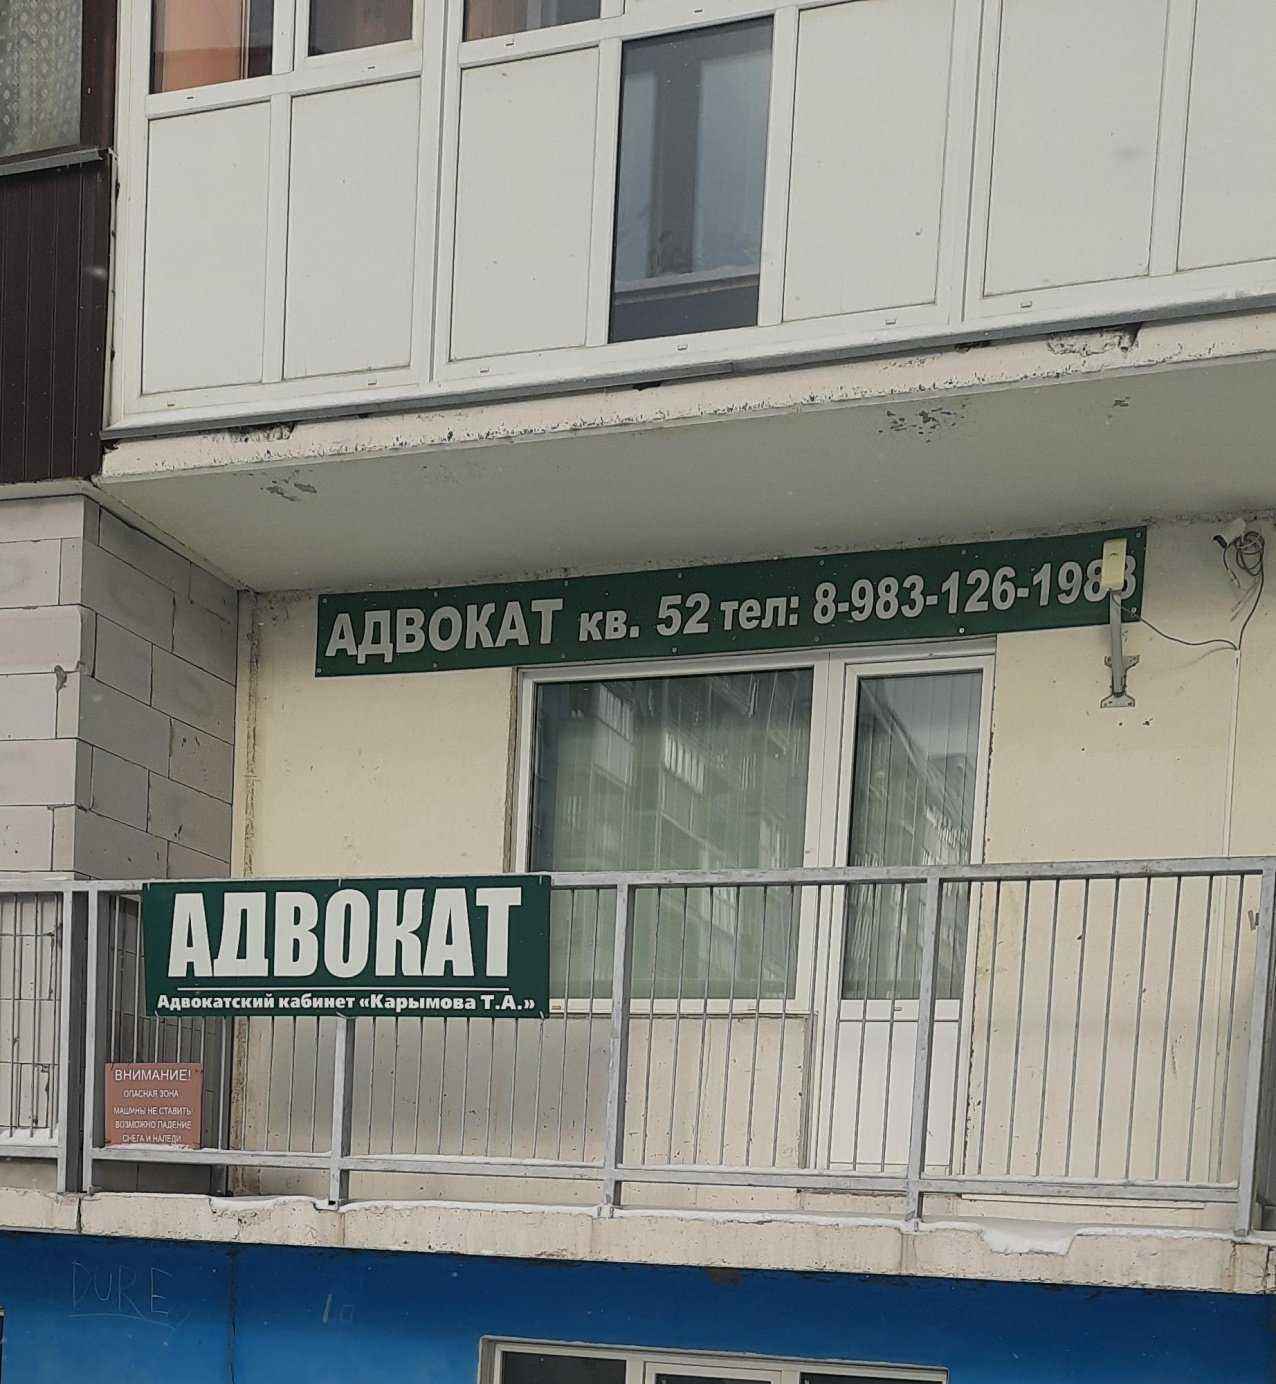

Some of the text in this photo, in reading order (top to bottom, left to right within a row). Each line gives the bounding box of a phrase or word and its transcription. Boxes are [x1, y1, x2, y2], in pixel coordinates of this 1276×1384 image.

[325, 598, 564, 664] АДВОКАТ
[579, 606, 640, 642] кв.
[656, 592, 711, 637] 52
[720, 594, 799, 631] тел:
[167, 887, 522, 978] АДВОКАТ
[157, 993, 536, 1012] Адвокатский кабинет «Карымова Т.А.»
[115, 1069, 191, 1081] ВНИМАНИЕ!
[123, 1088, 179, 1098] ОПАСНАЯ ЗОНА
[147, 1106, 158, 1115] НЕ
[115, 1120, 192, 1130] ВОЗМОЖНО ПАДЕНИЕ
